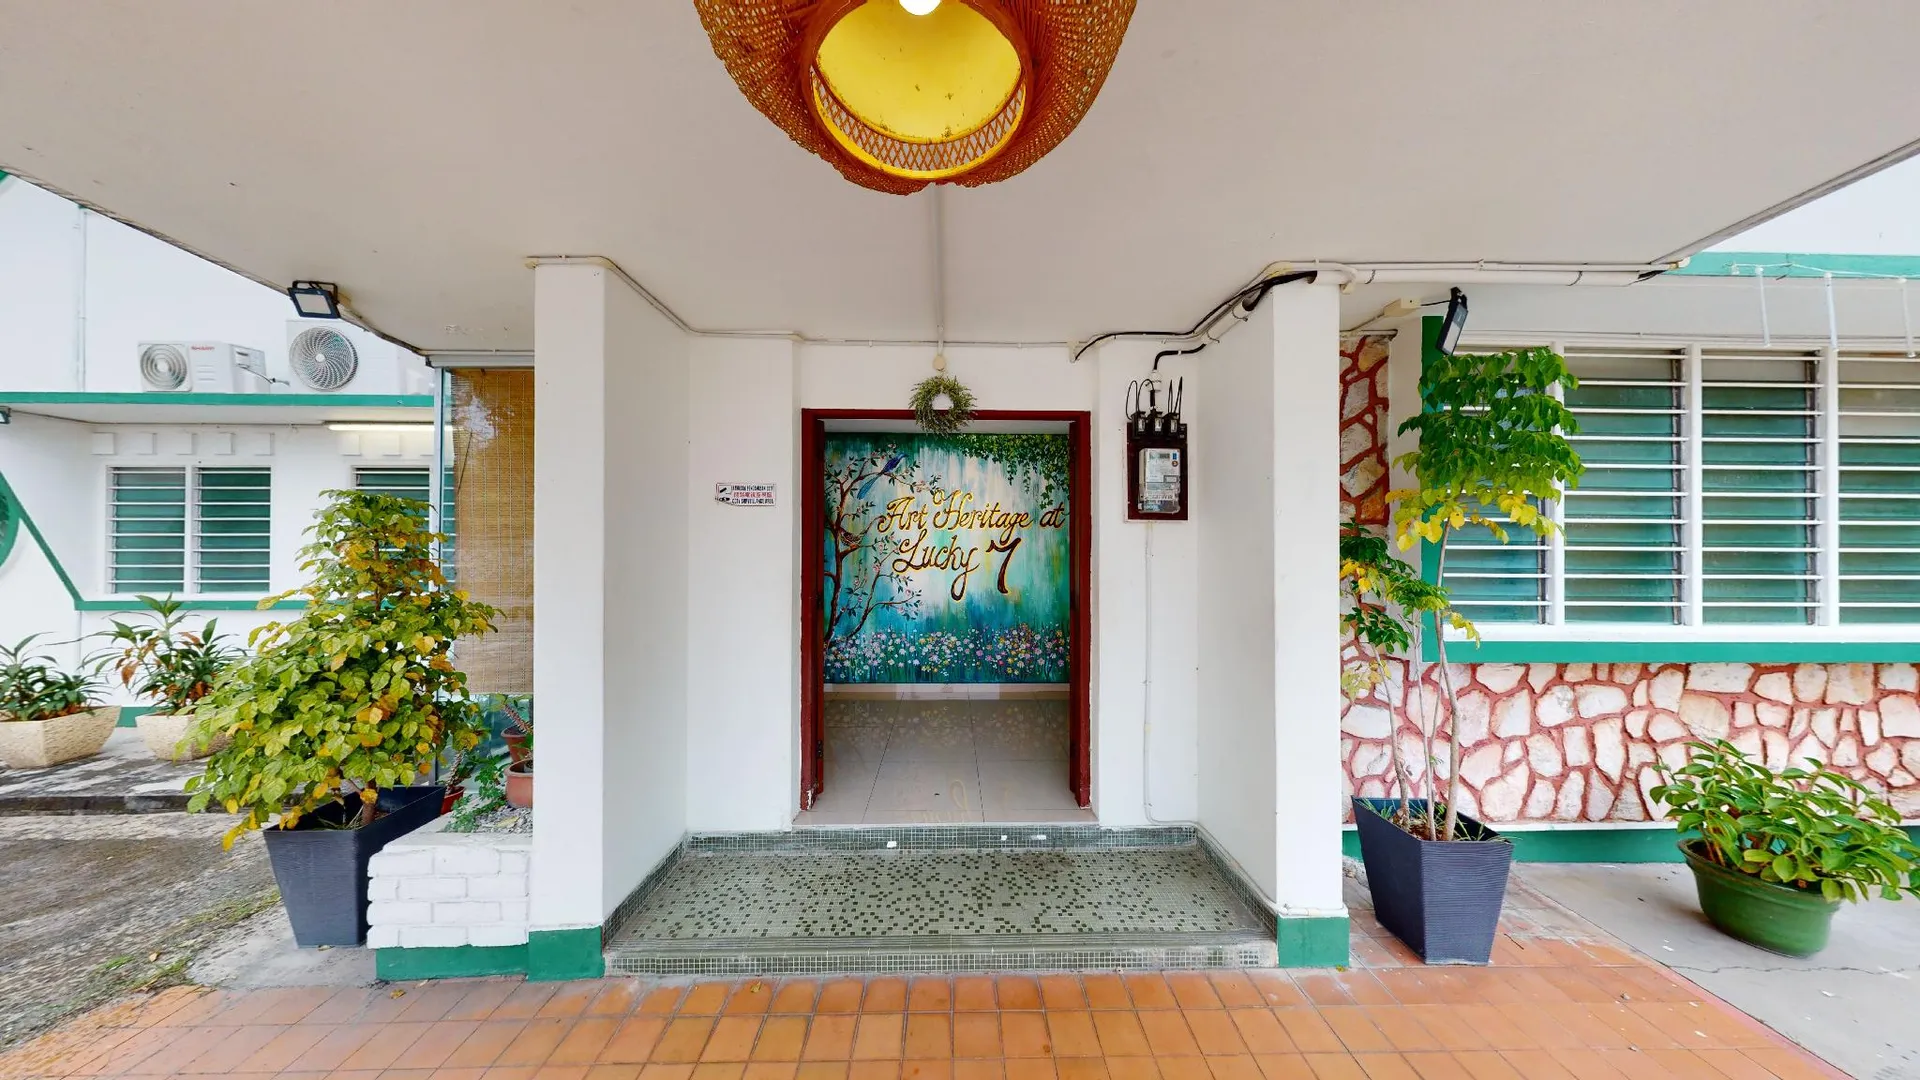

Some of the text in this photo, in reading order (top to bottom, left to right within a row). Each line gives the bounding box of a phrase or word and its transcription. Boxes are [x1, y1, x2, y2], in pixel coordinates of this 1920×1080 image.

[877, 488, 1071, 546] Art Heritage at
[892, 529, 1022, 601] Lucky 7
